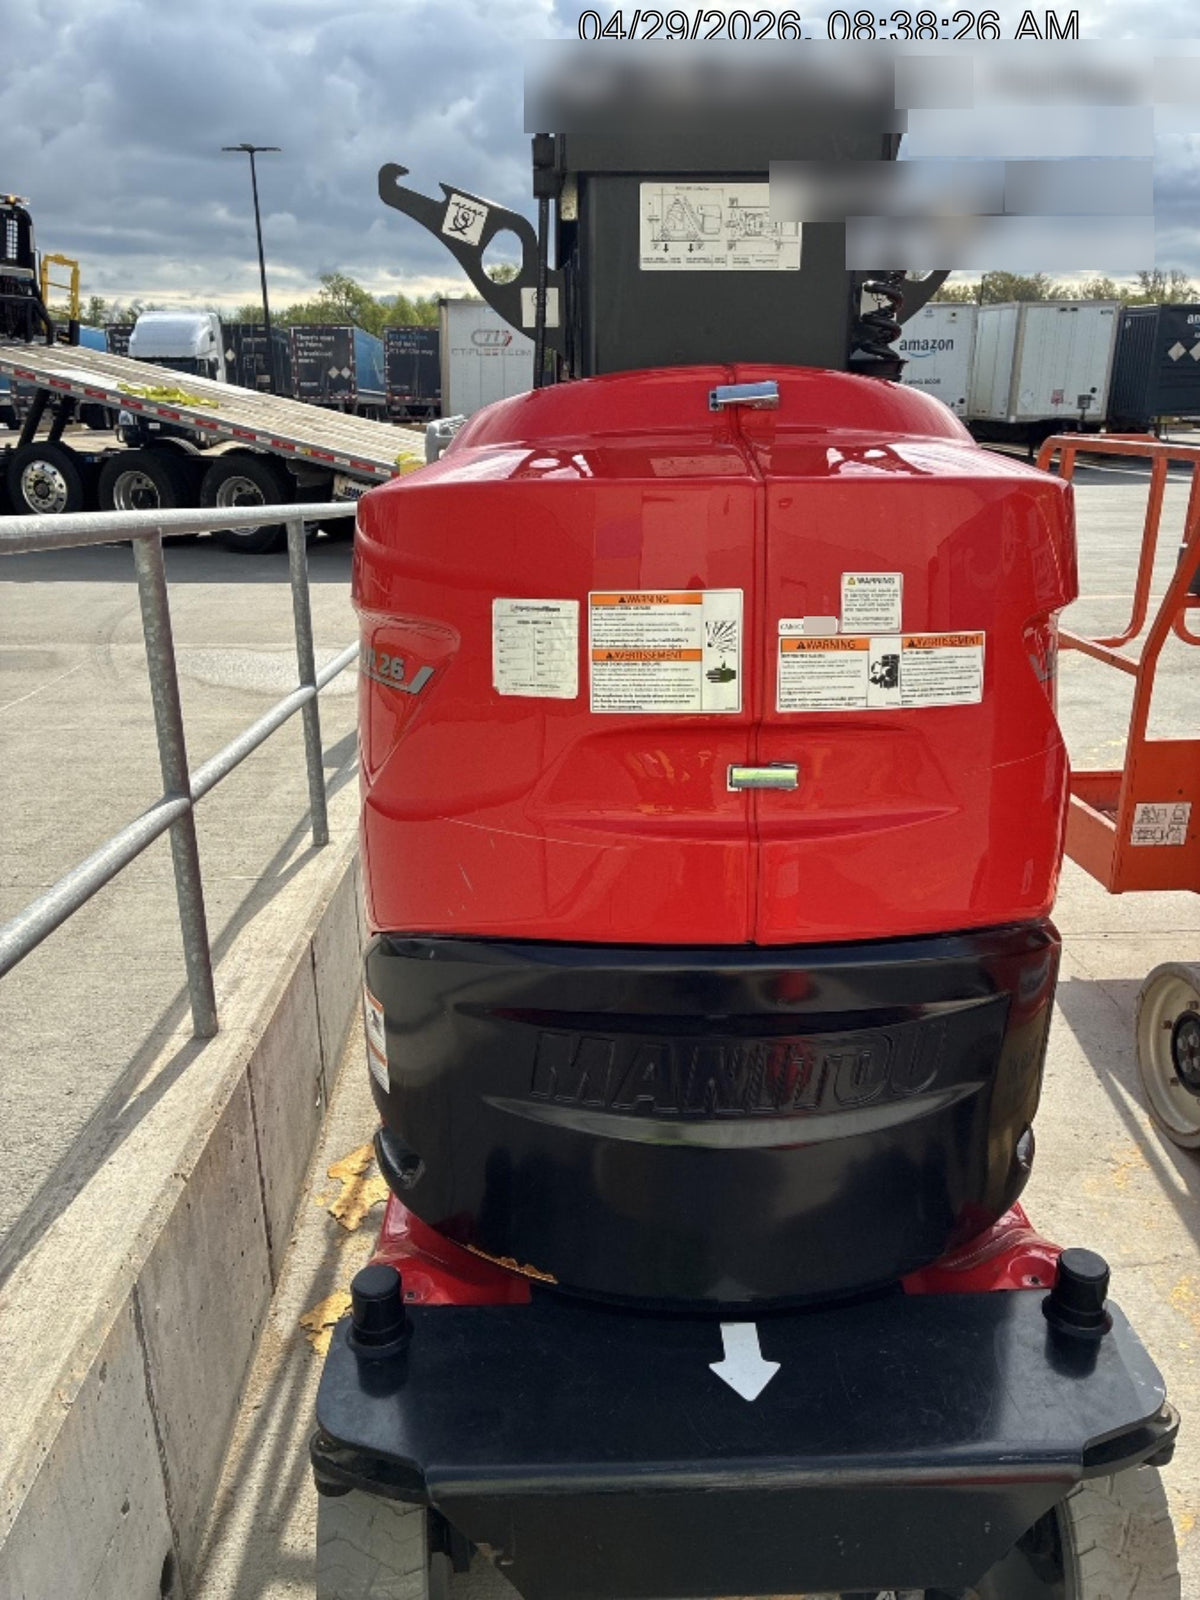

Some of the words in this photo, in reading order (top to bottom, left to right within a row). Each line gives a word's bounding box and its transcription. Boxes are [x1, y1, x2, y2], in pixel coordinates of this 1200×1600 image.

[900, 339, 954, 351] amazon
[626, 594, 670, 604] WARNING
[807, 639, 856, 651] WARNING
[379, 652, 405, 681] 26
[529, 1022, 947, 1114] MANITOU
